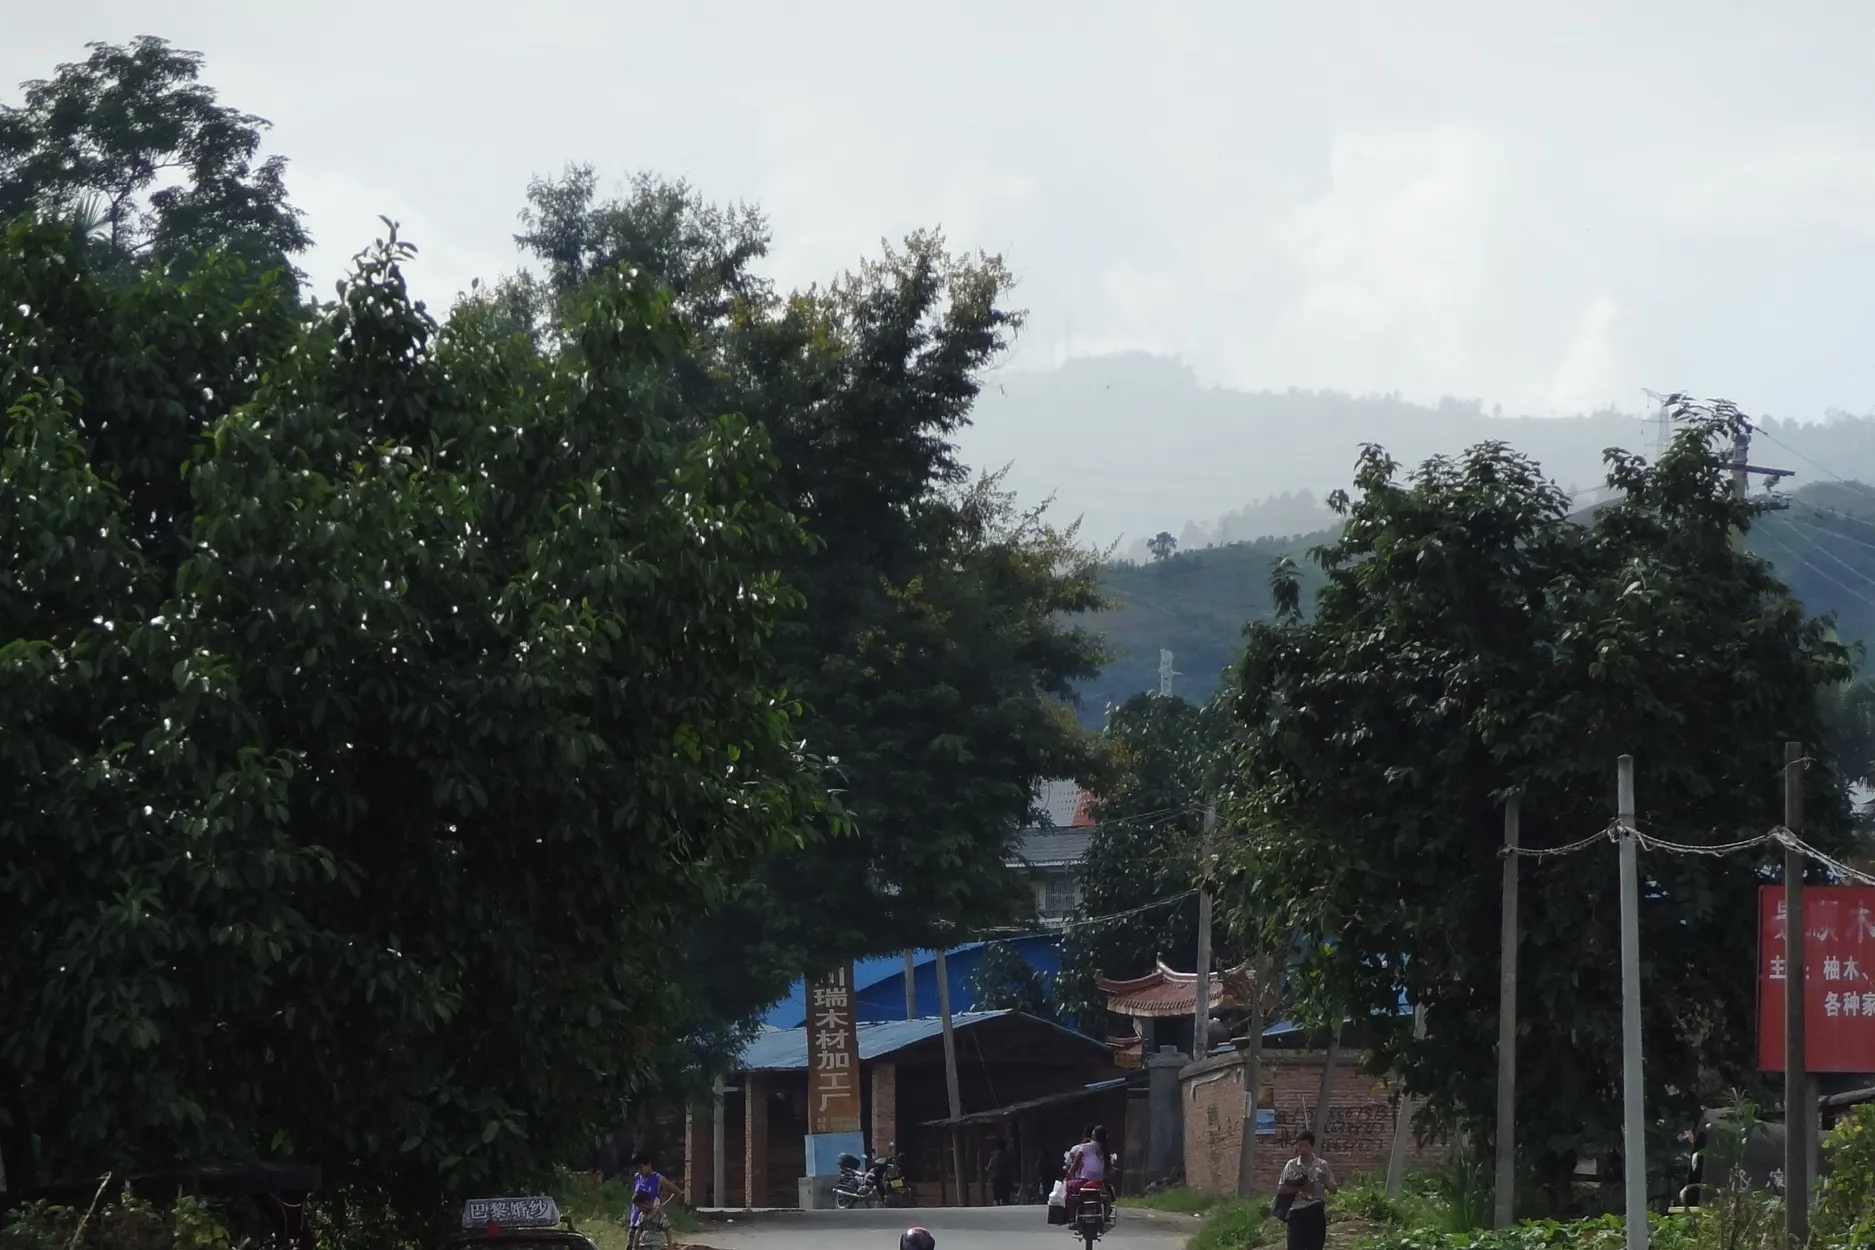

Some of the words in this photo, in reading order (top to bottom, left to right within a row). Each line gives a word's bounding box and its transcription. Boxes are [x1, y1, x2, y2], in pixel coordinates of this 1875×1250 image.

[1824, 990, 1875, 1017] 各种家
[470, 1200, 548, 1219] 巴黎婚纱
